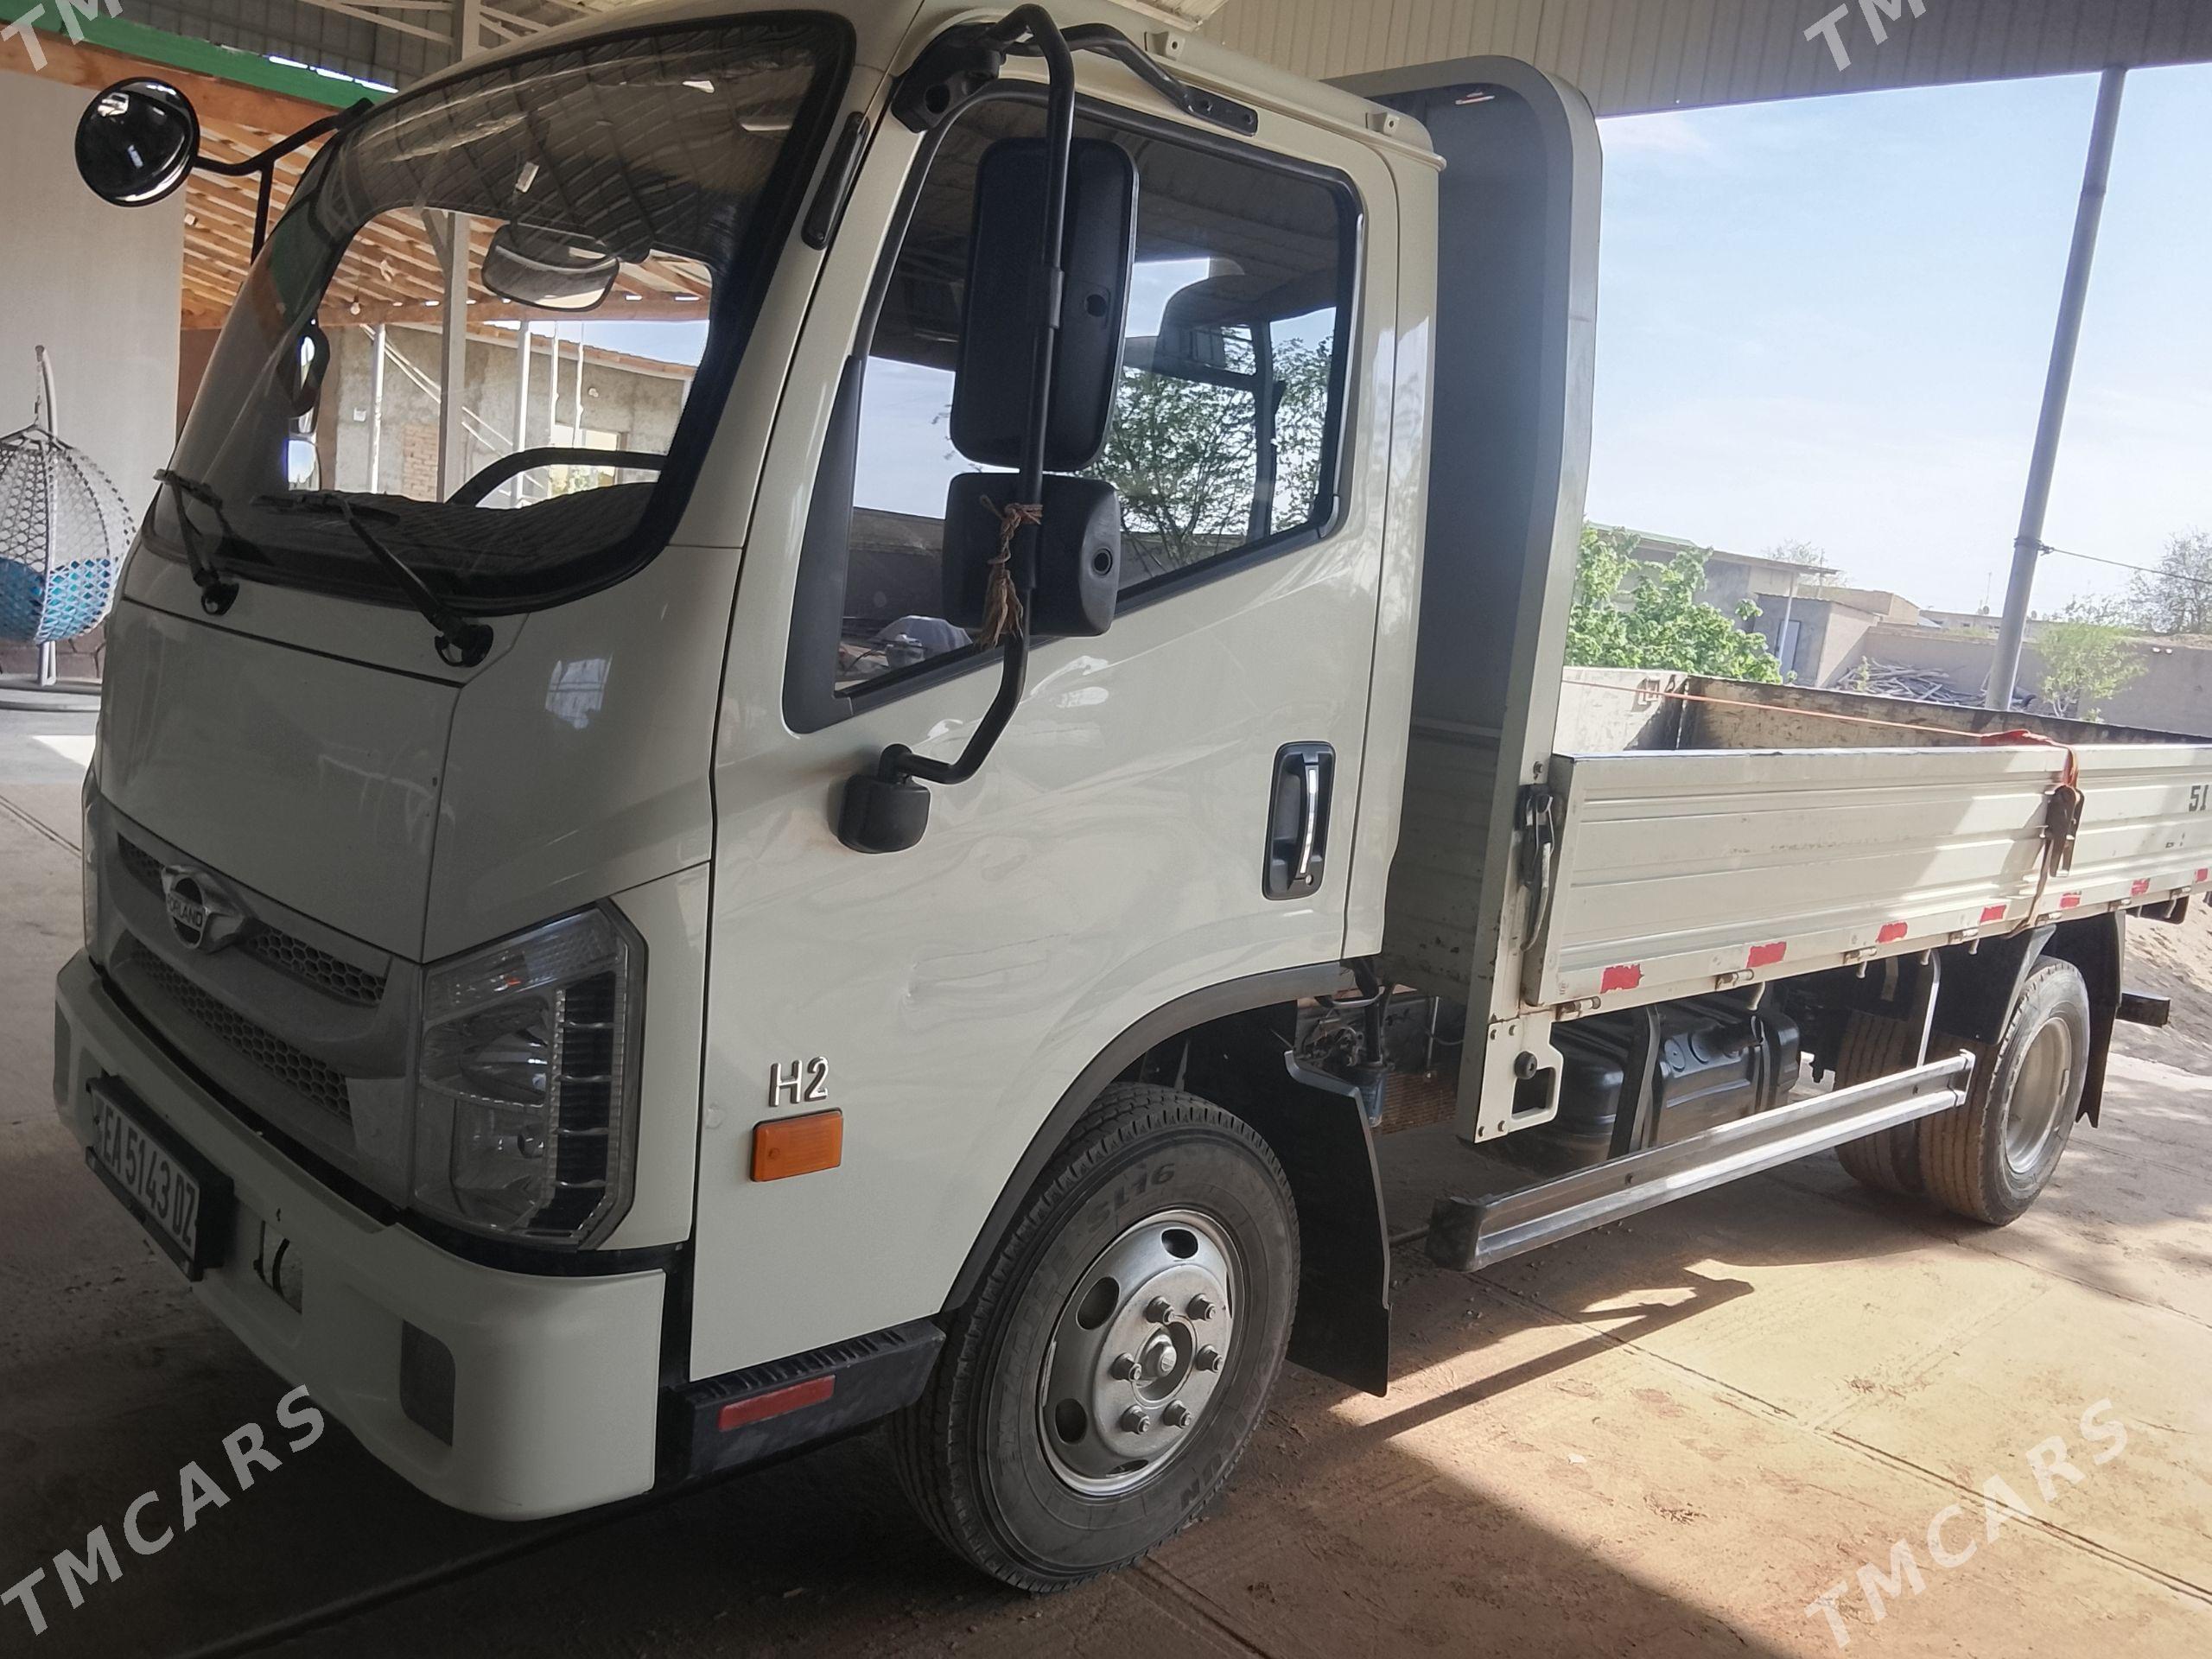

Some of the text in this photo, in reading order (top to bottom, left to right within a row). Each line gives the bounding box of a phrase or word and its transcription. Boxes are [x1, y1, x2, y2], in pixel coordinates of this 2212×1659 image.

[2189, 785, 2209, 811] 51
[772, 1059, 828, 1107] H2
[124, 1127, 171, 1220] 5143
